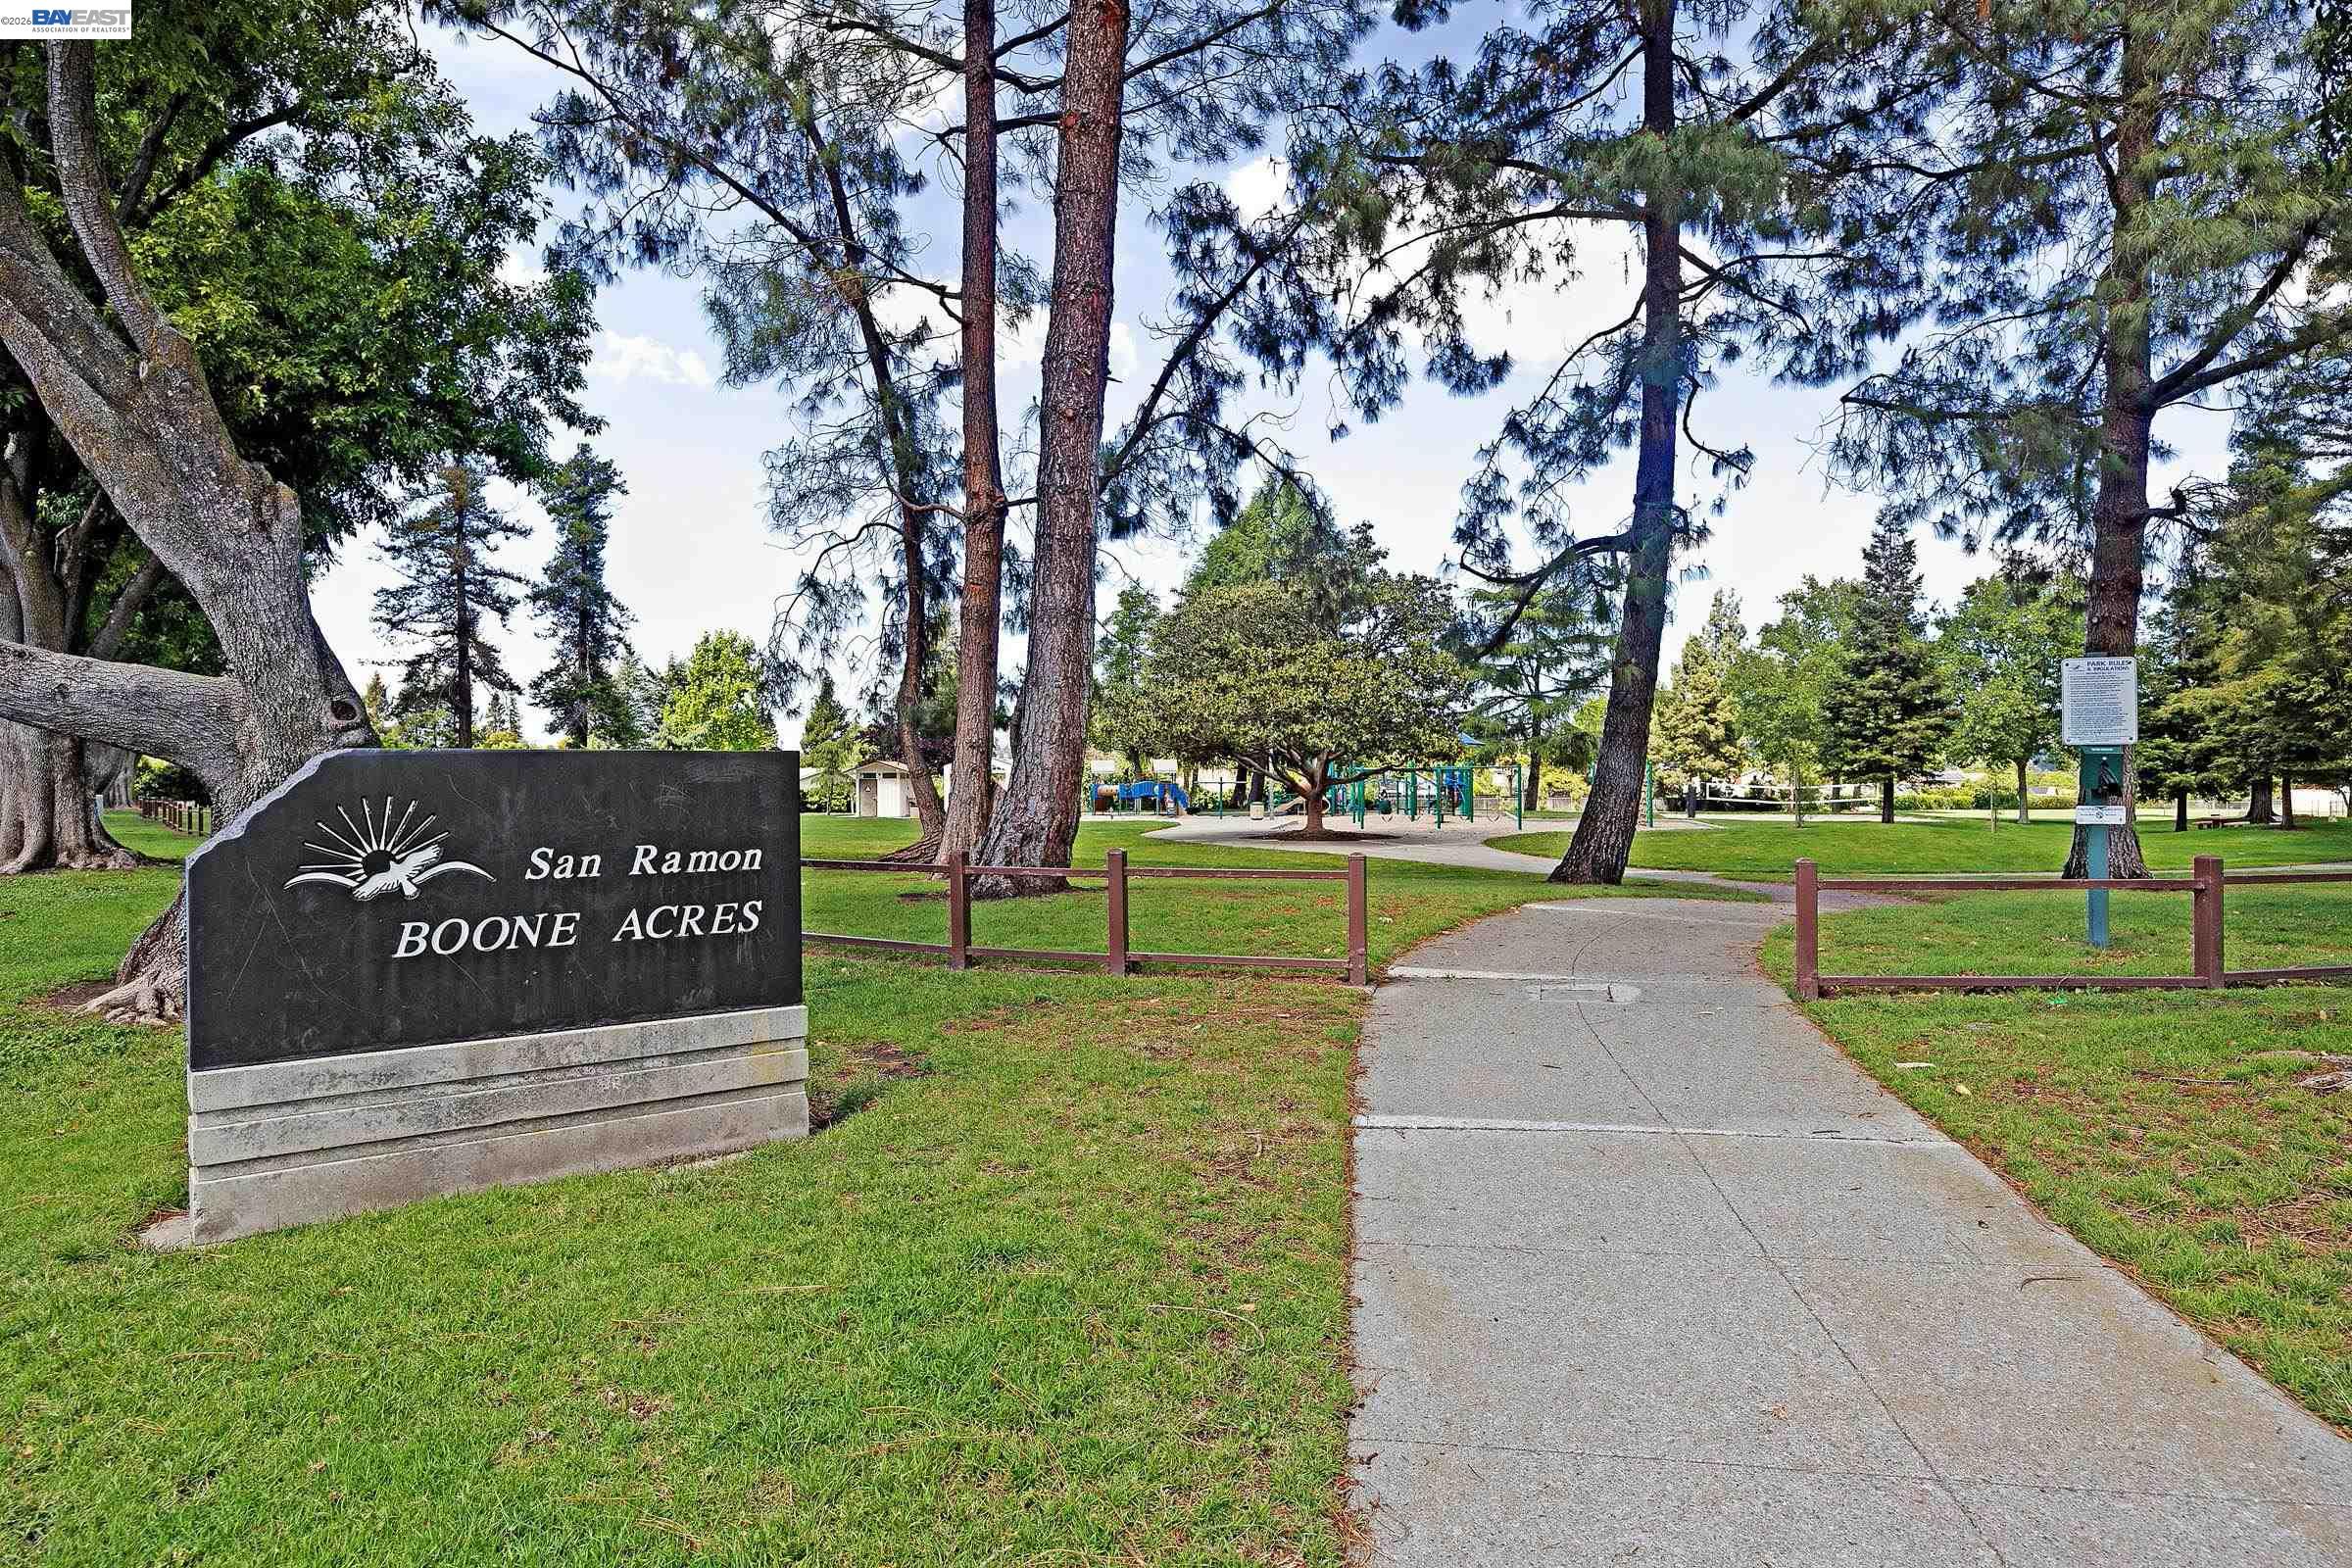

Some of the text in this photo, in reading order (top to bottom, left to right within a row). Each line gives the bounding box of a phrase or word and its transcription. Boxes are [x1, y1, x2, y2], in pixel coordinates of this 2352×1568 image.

[524, 845, 763, 881] San Ramon
[393, 900, 763, 958] BOONE ACRES
